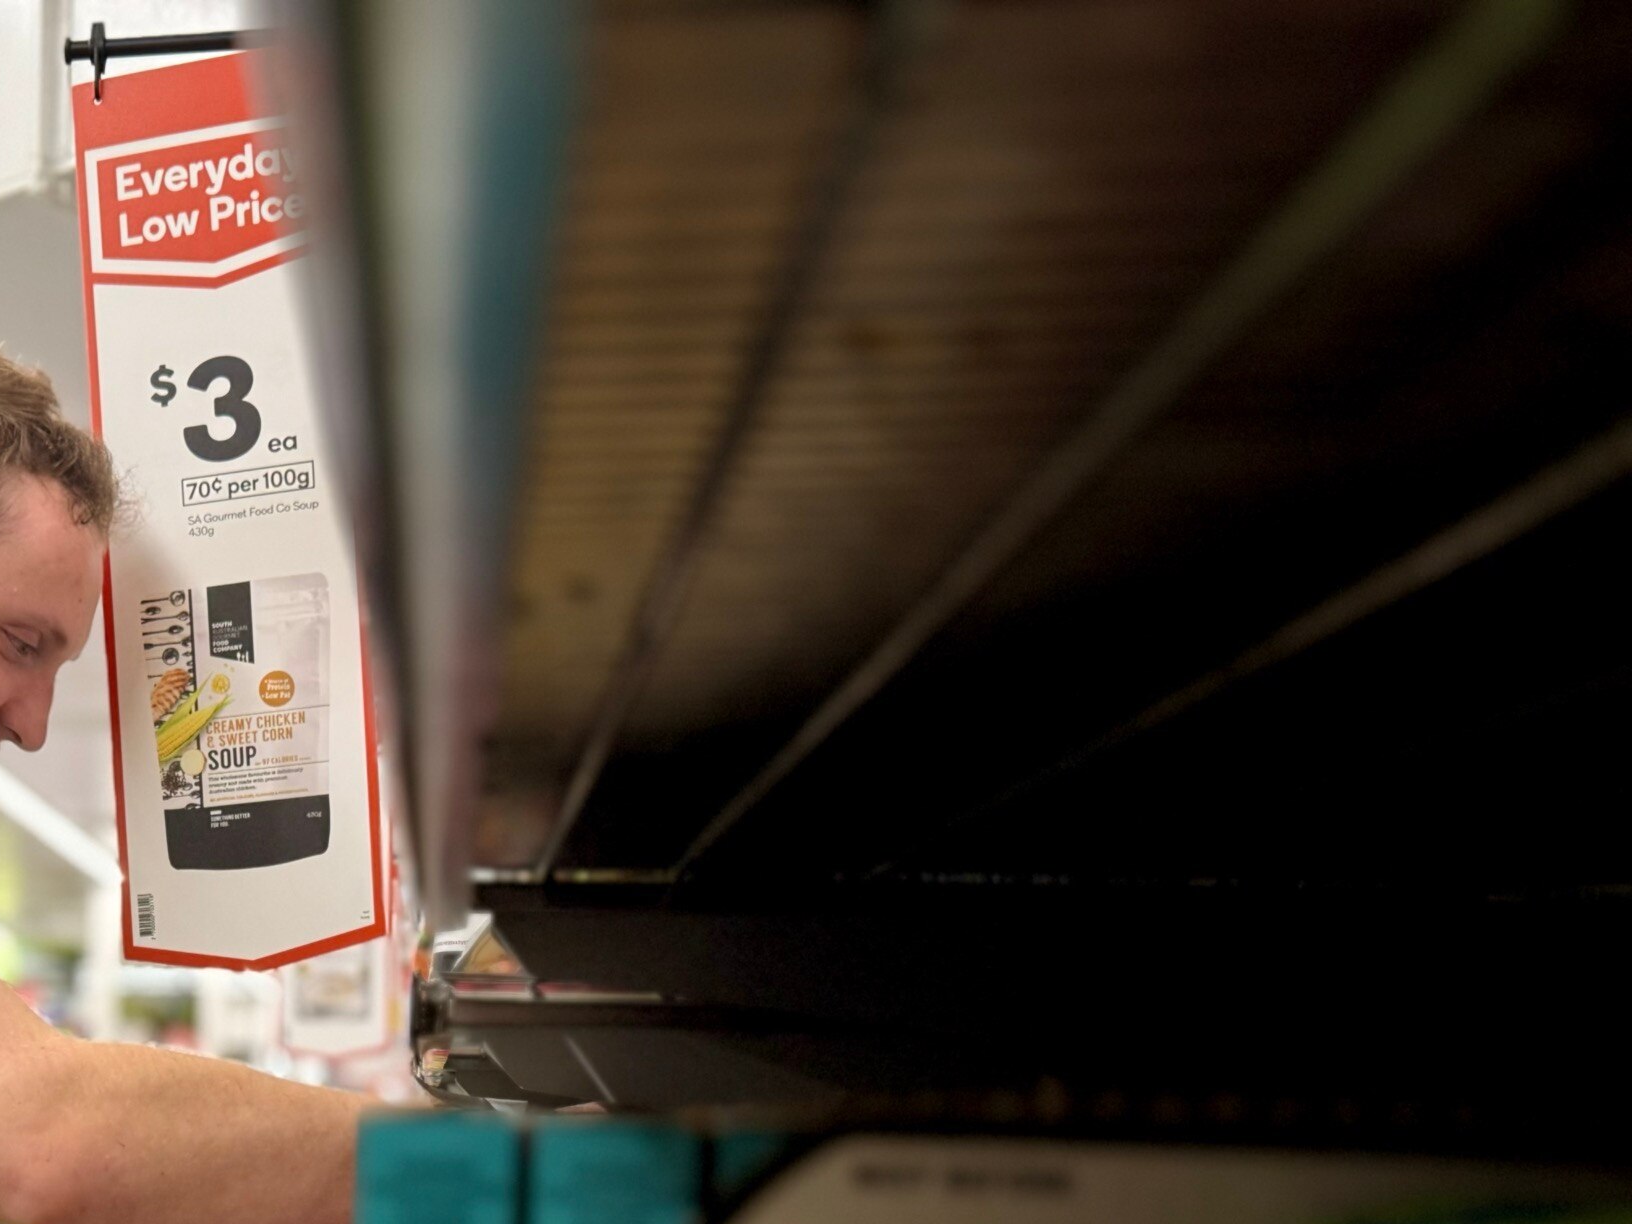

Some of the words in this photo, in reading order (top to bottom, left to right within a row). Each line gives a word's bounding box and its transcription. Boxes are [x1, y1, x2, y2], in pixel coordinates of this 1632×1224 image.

[119, 209, 199, 247] Low
[268, 435, 298, 452] ea
[228, 478, 259, 499] per
[262, 469, 310, 489] 100g
[188, 516, 201, 526] SA
[204, 509, 247, 523] Gourmet
[249, 505, 274, 517] Food
[276, 503, 290, 513] Co
[293, 501, 319, 512] Soup
[188, 526, 215, 538] 430g
[206, 717, 253, 735] CREAMY
[256, 710, 306, 729] CHICKEN
[219, 731, 258, 747] SWEET
[262, 726, 294, 742] CORN
[208, 745, 257, 771] SOUP
